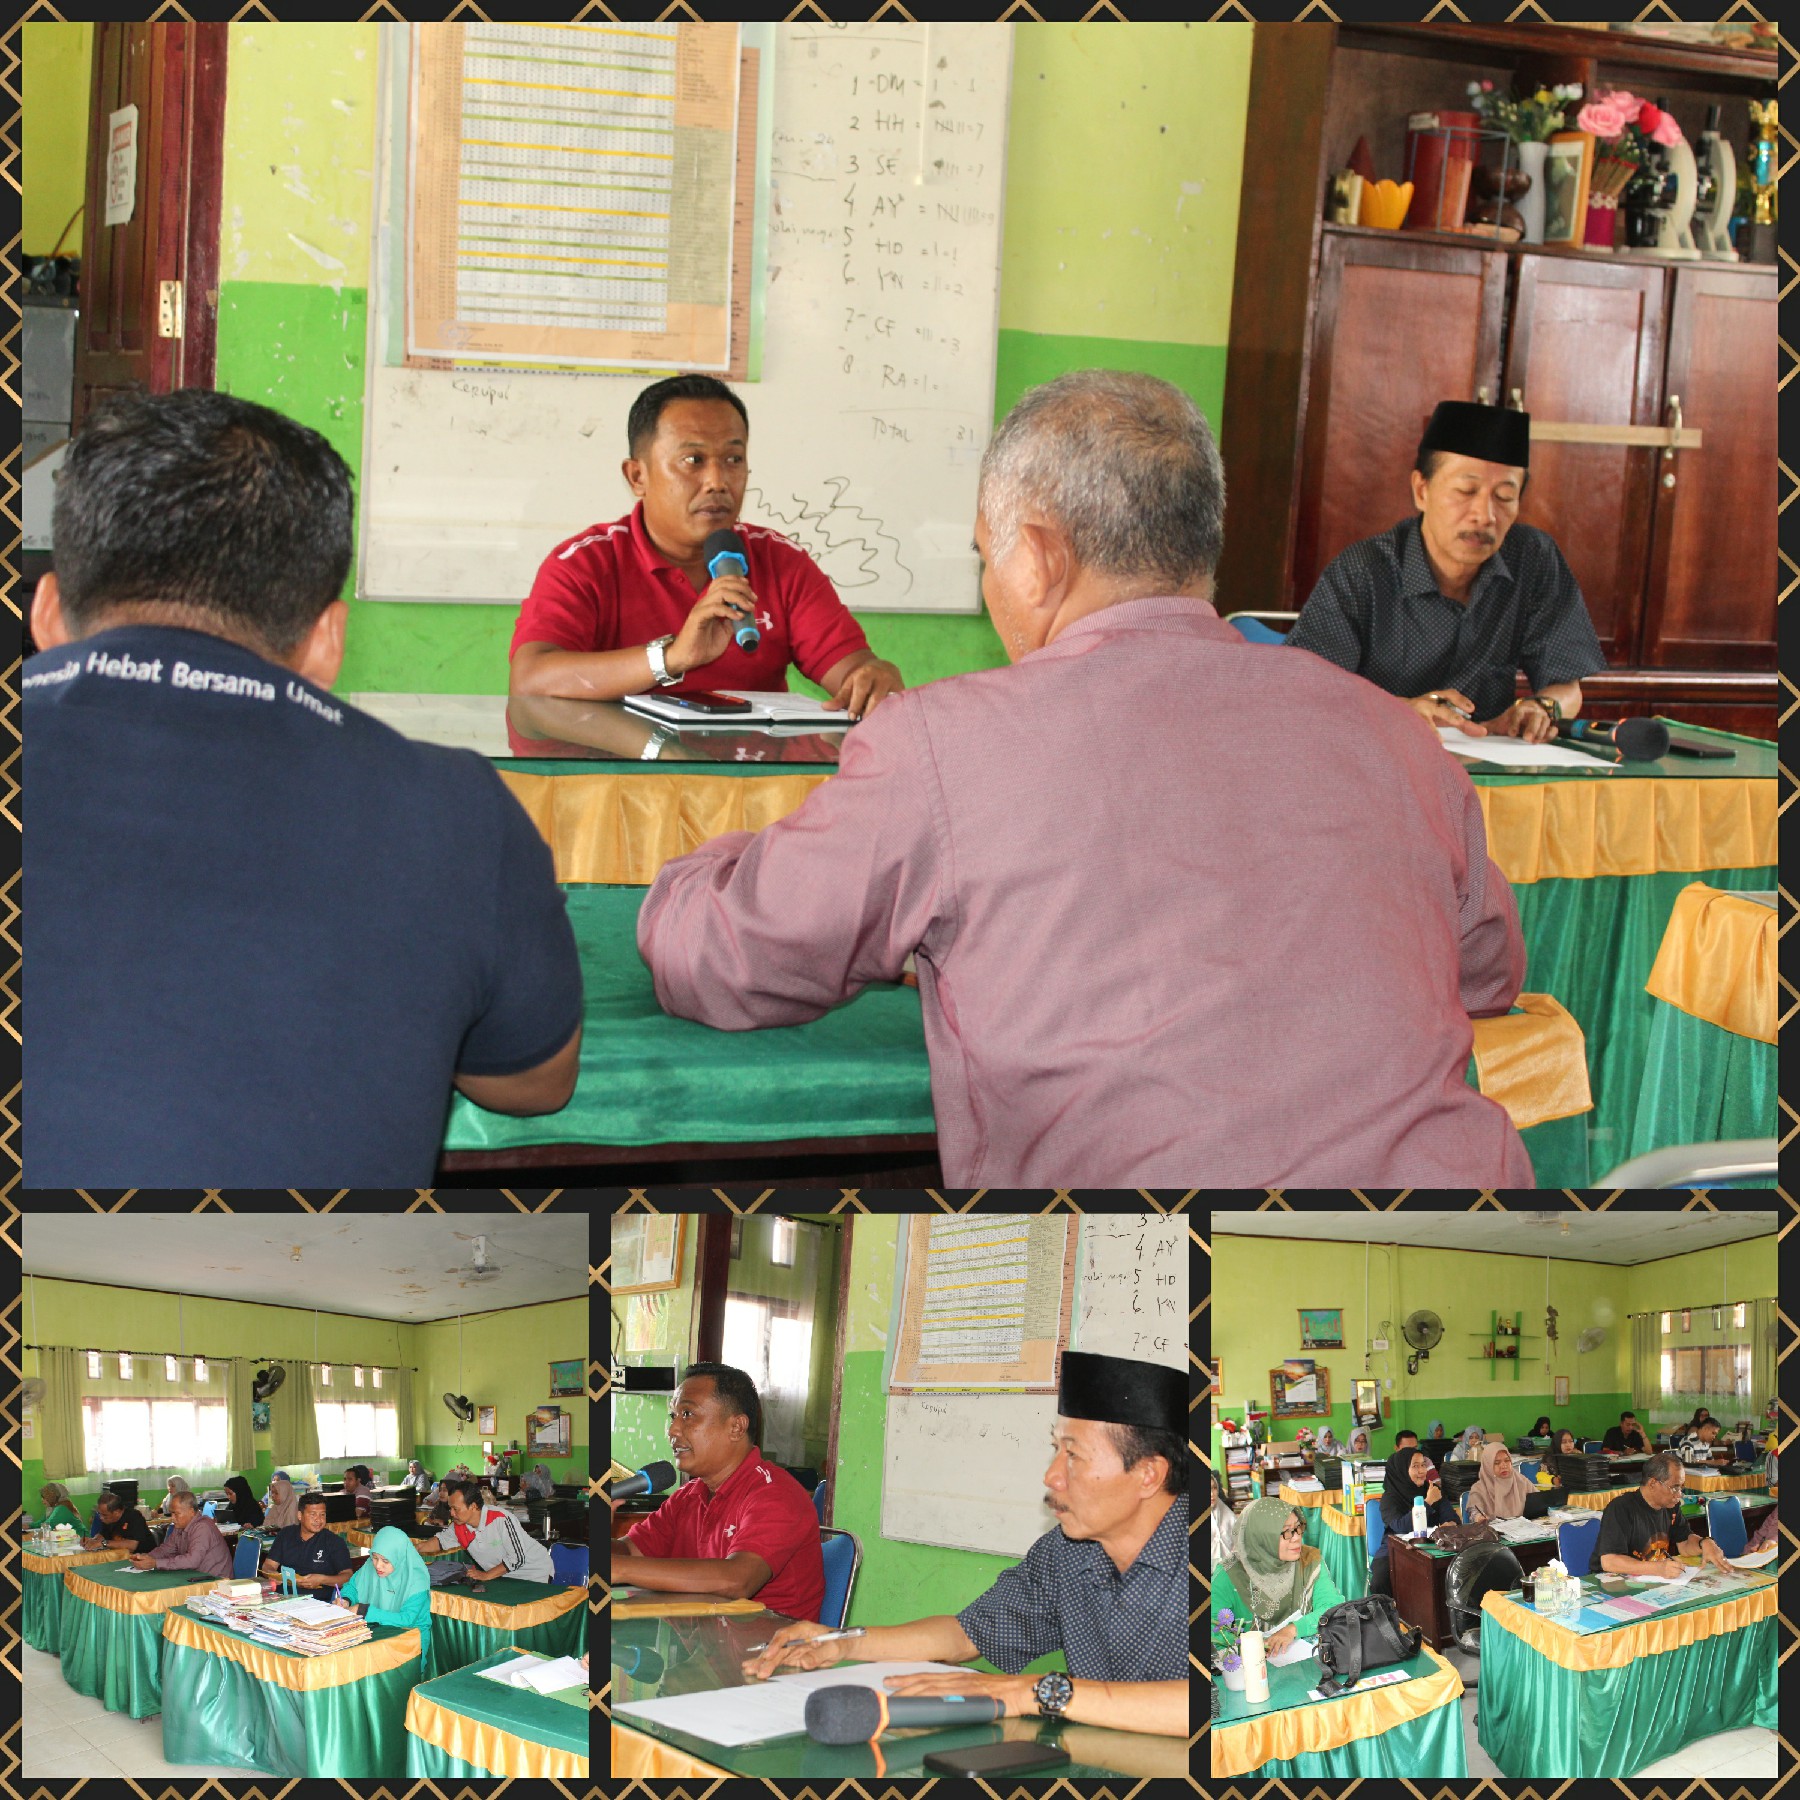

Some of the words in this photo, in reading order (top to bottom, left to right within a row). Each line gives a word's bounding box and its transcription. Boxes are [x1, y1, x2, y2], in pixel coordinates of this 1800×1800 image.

[849, 115, 860, 131] 2
[875, 109, 904, 133] HH
[845, 154, 859, 174] 3
[876, 154, 899, 175] SE
[843, 183, 856, 217] 4
[843, 226, 854, 247] 5
[85, 651, 164, 683] Hebat
[171, 661, 276, 702] Bersama
[285, 681, 344, 727] Umat
[1136, 1233, 1144, 1261] 4
[1133, 1269, 1142, 1285] 5
